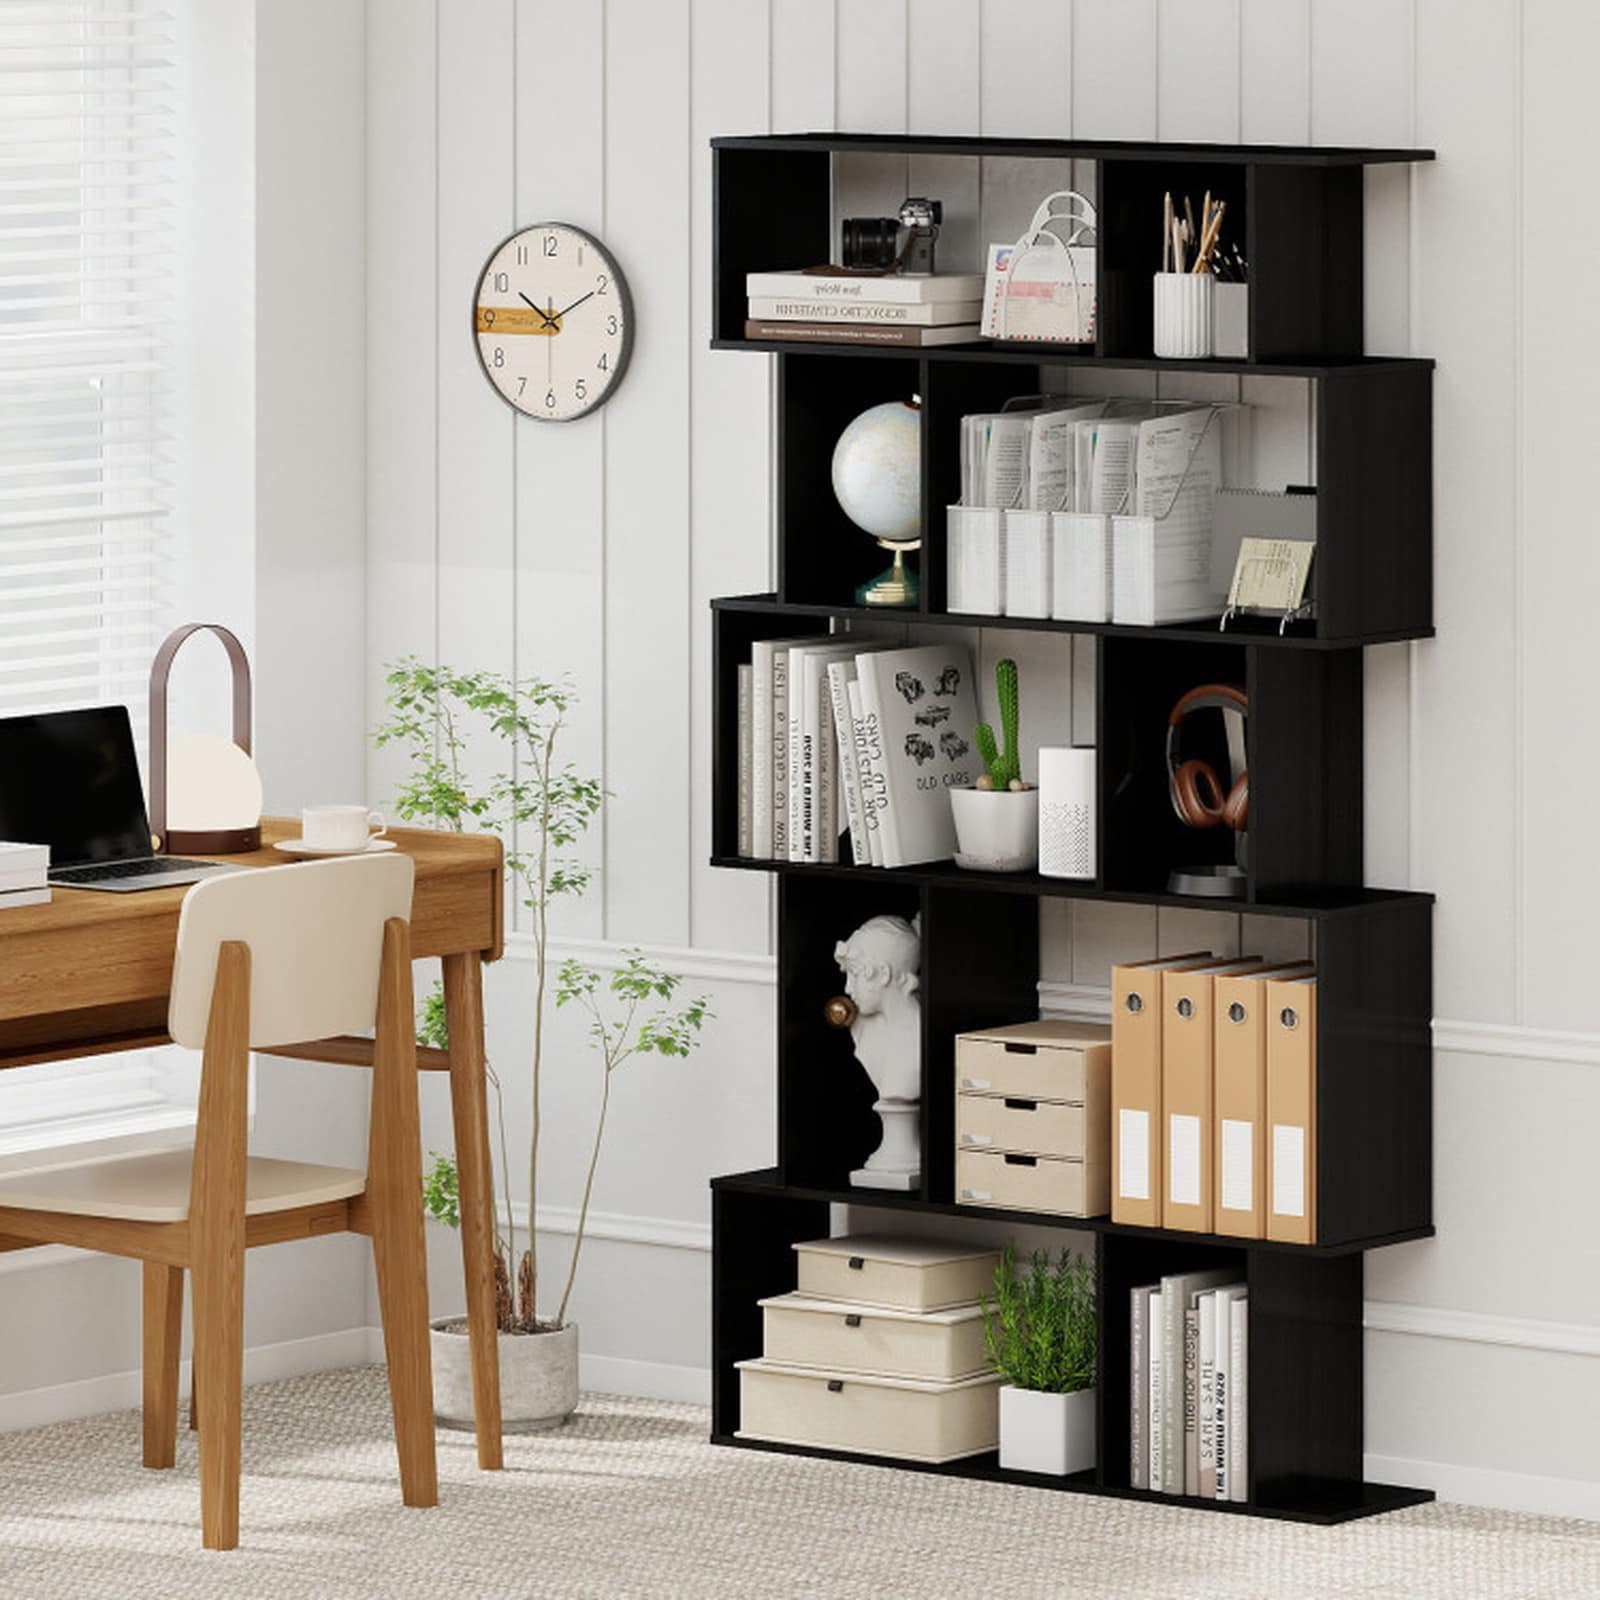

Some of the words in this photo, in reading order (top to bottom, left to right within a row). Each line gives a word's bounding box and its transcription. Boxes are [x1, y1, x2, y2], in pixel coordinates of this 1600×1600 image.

[517, 246, 528, 265] 11
[543, 236, 557, 257] 12
[494, 272, 508, 293] 10
[596, 274, 608, 295] 2
[483, 308, 496, 328] 9
[607, 315, 617, 336] 3
[494, 347, 505, 368] 8
[596, 352, 608, 372] 4
[517, 377, 527, 396] 7
[575, 379, 587, 400] 5
[545, 388, 556, 408] 6
[773, 661, 786, 699] fish
[776, 712, 786, 723] a
[865, 713, 882, 760] CARS
[773, 731, 786, 782] catch
[853, 717, 874, 788] HISTORY
[874, 773, 889, 809] OLD
[916, 776, 937, 791] OLD
[942, 771, 970, 788] CARS
[774, 791, 785, 810] to
[864, 799, 880, 831] CAR
[774, 821, 785, 852] How
[1214, 1372, 1225, 1405] 2020
[1216, 1407, 1225, 1422] IN
[1216, 1424, 1226, 1469] WORLD
